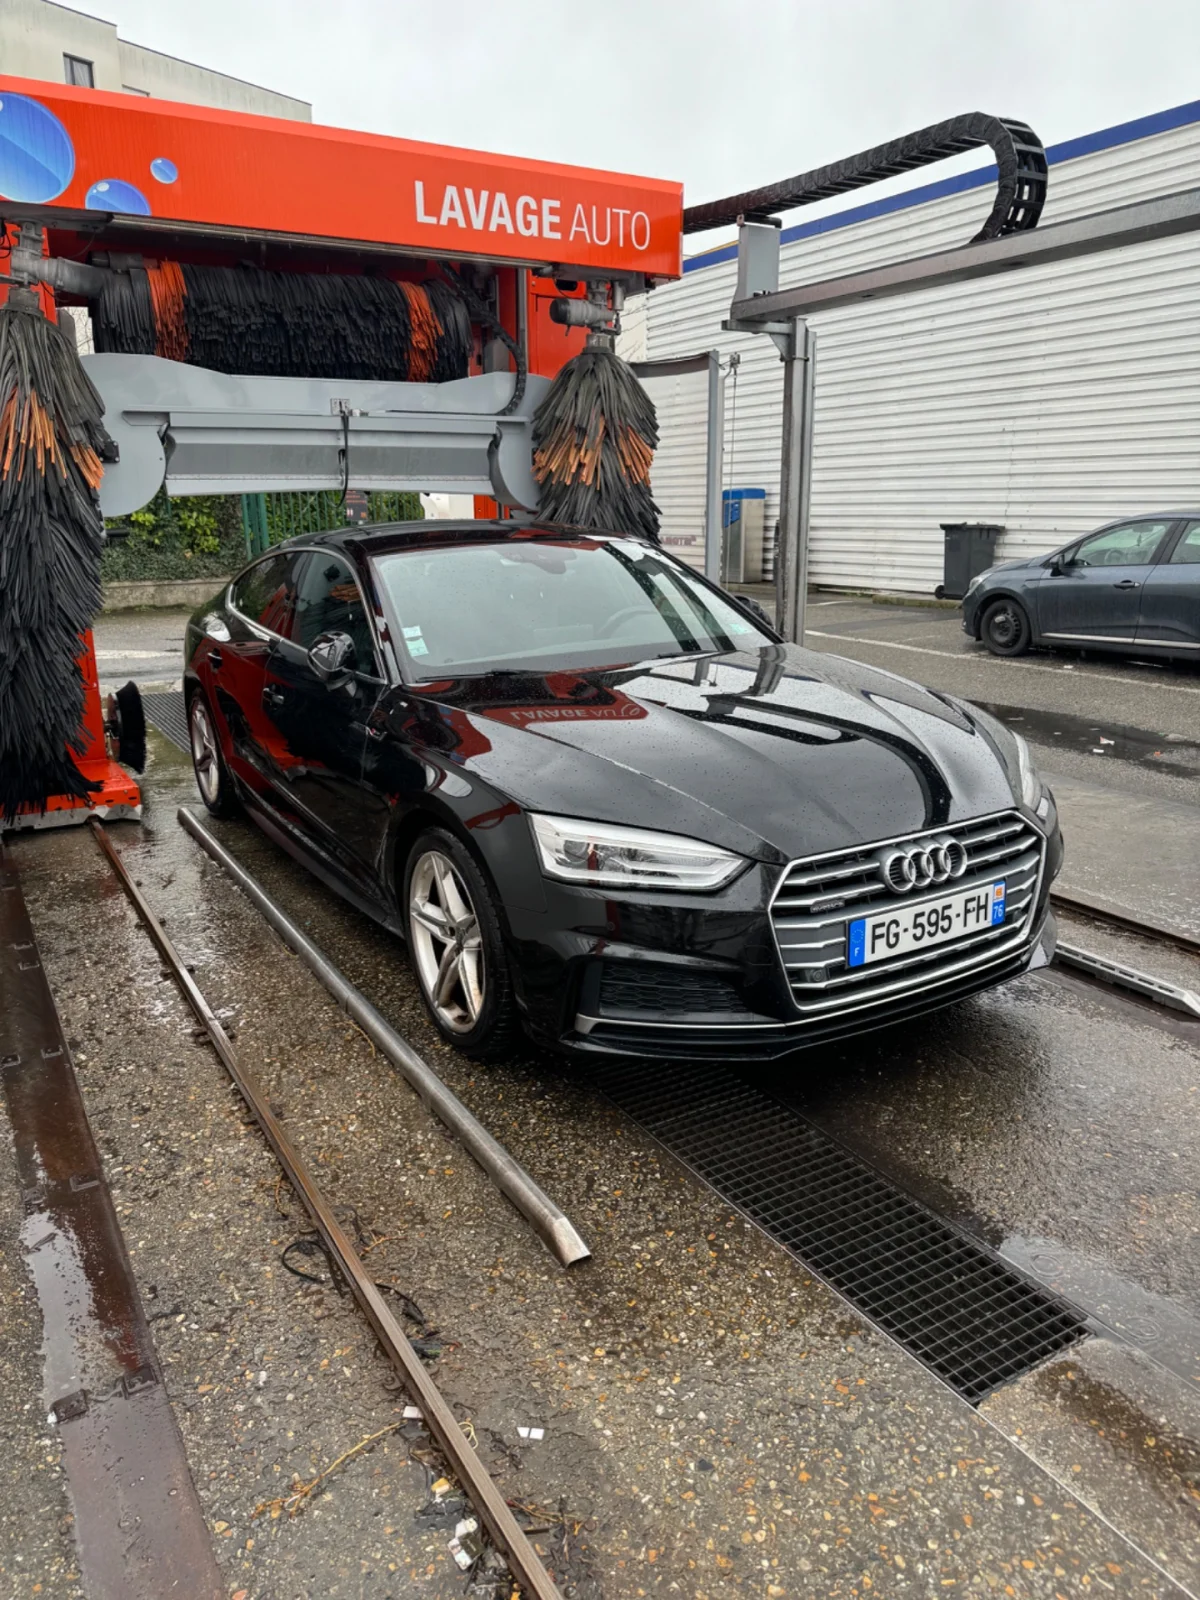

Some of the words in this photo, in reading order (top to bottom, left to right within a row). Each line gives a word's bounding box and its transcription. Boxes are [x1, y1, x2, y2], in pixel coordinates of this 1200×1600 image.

[414, 180, 562, 240] LAVAGE
[568, 203, 651, 250] AUTO
[871, 892, 989, 954] FG-595-FH
[993, 904, 1004, 919] 76
[854, 947, 860, 957] F
